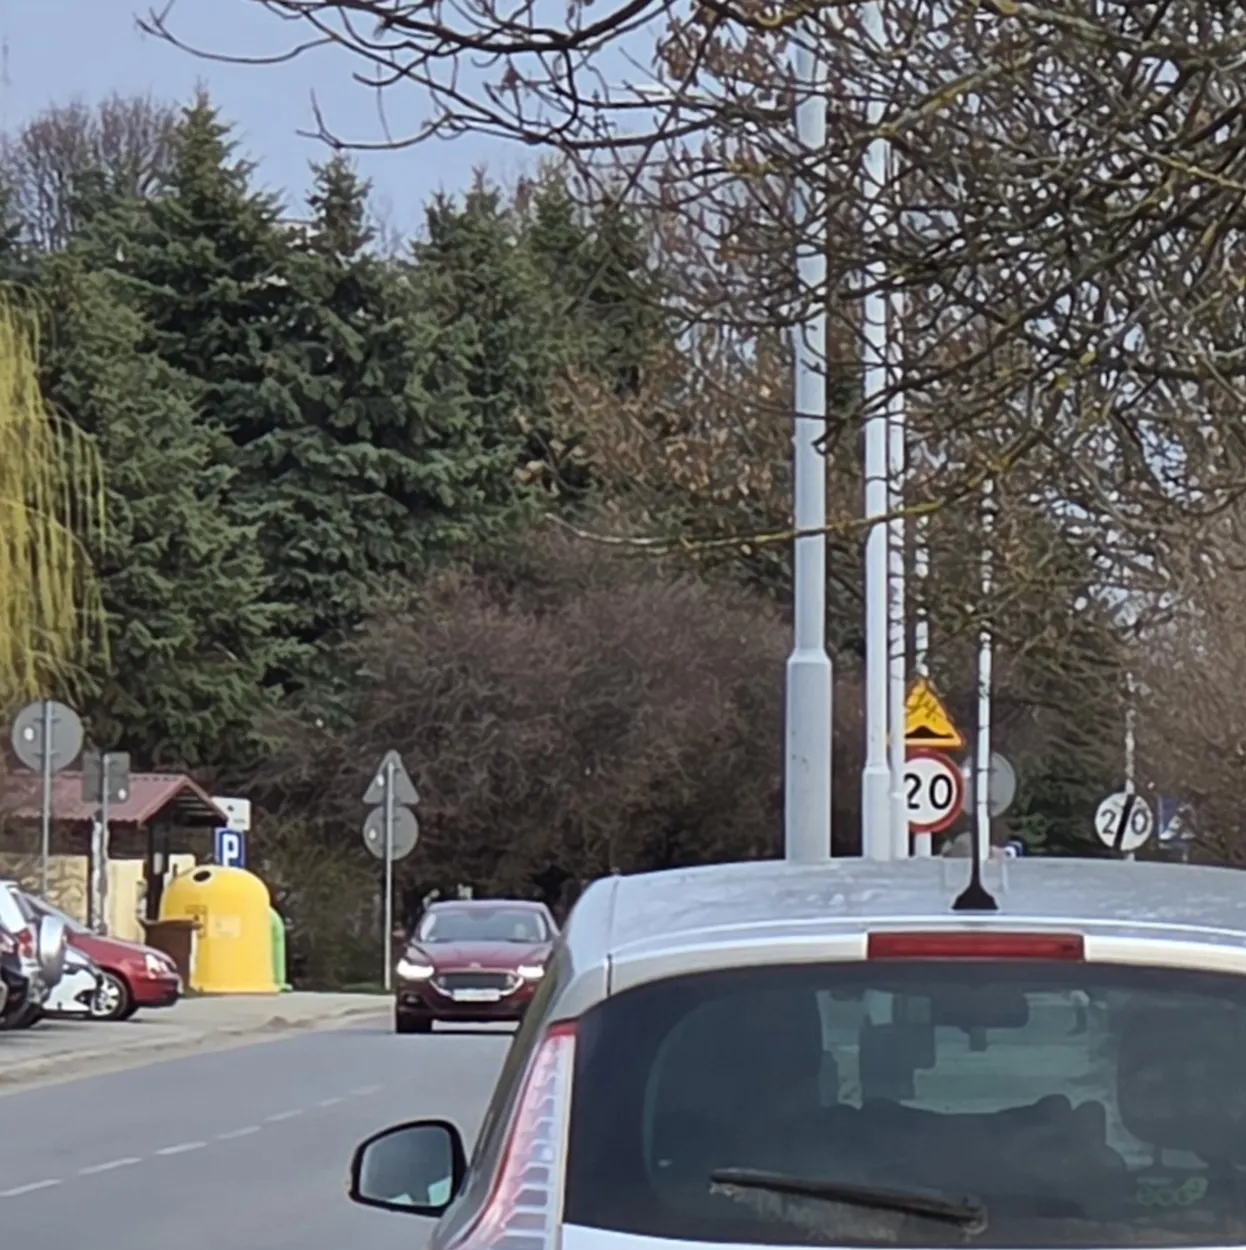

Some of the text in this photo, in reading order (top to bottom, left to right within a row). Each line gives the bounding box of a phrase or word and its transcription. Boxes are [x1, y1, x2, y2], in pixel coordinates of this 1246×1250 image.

[904, 773, 953, 810] 20
[1100, 808, 1149, 835] 20
[222, 833, 239, 867] P
